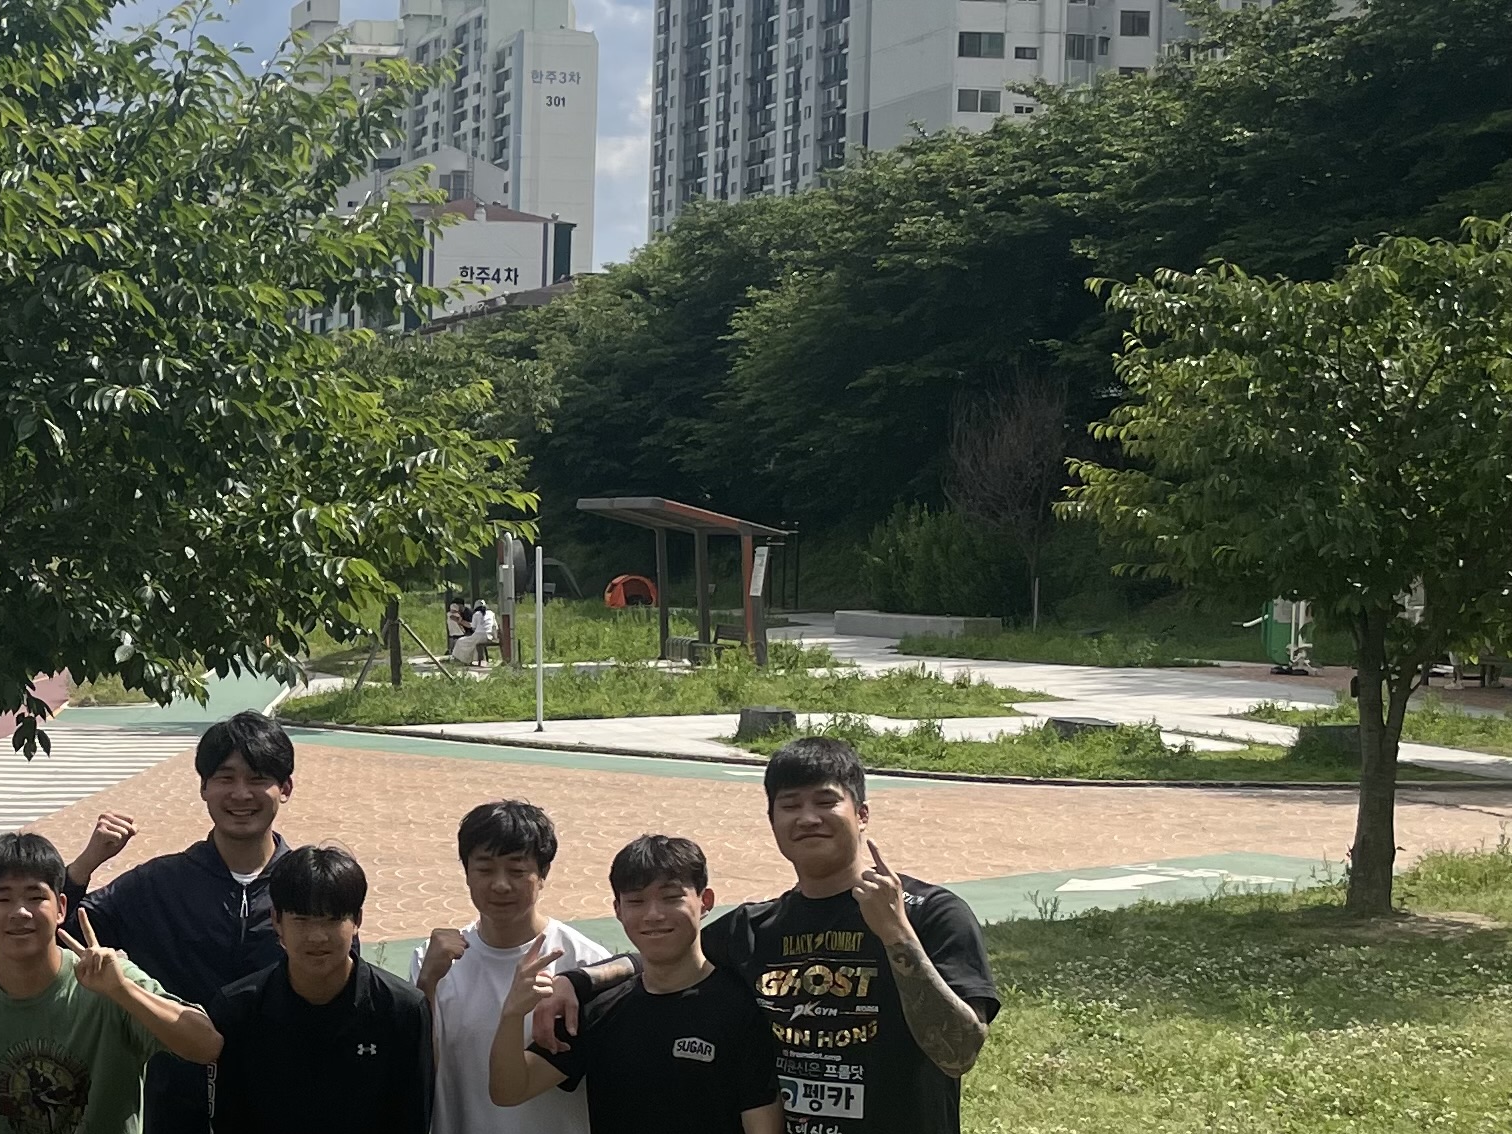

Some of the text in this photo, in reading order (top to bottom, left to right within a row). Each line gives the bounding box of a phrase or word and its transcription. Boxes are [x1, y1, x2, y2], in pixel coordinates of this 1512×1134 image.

[531, 69, 581, 85] 한주3차
[545, 95, 566, 108] 301
[459, 265, 519, 286] 한주4차
[782, 930, 864, 956] BLACK COMBAT
[755, 964, 878, 998] GHOST
[677, 1040, 712, 1056] SUGAR
[802, 1083, 855, 1112] 펭카
